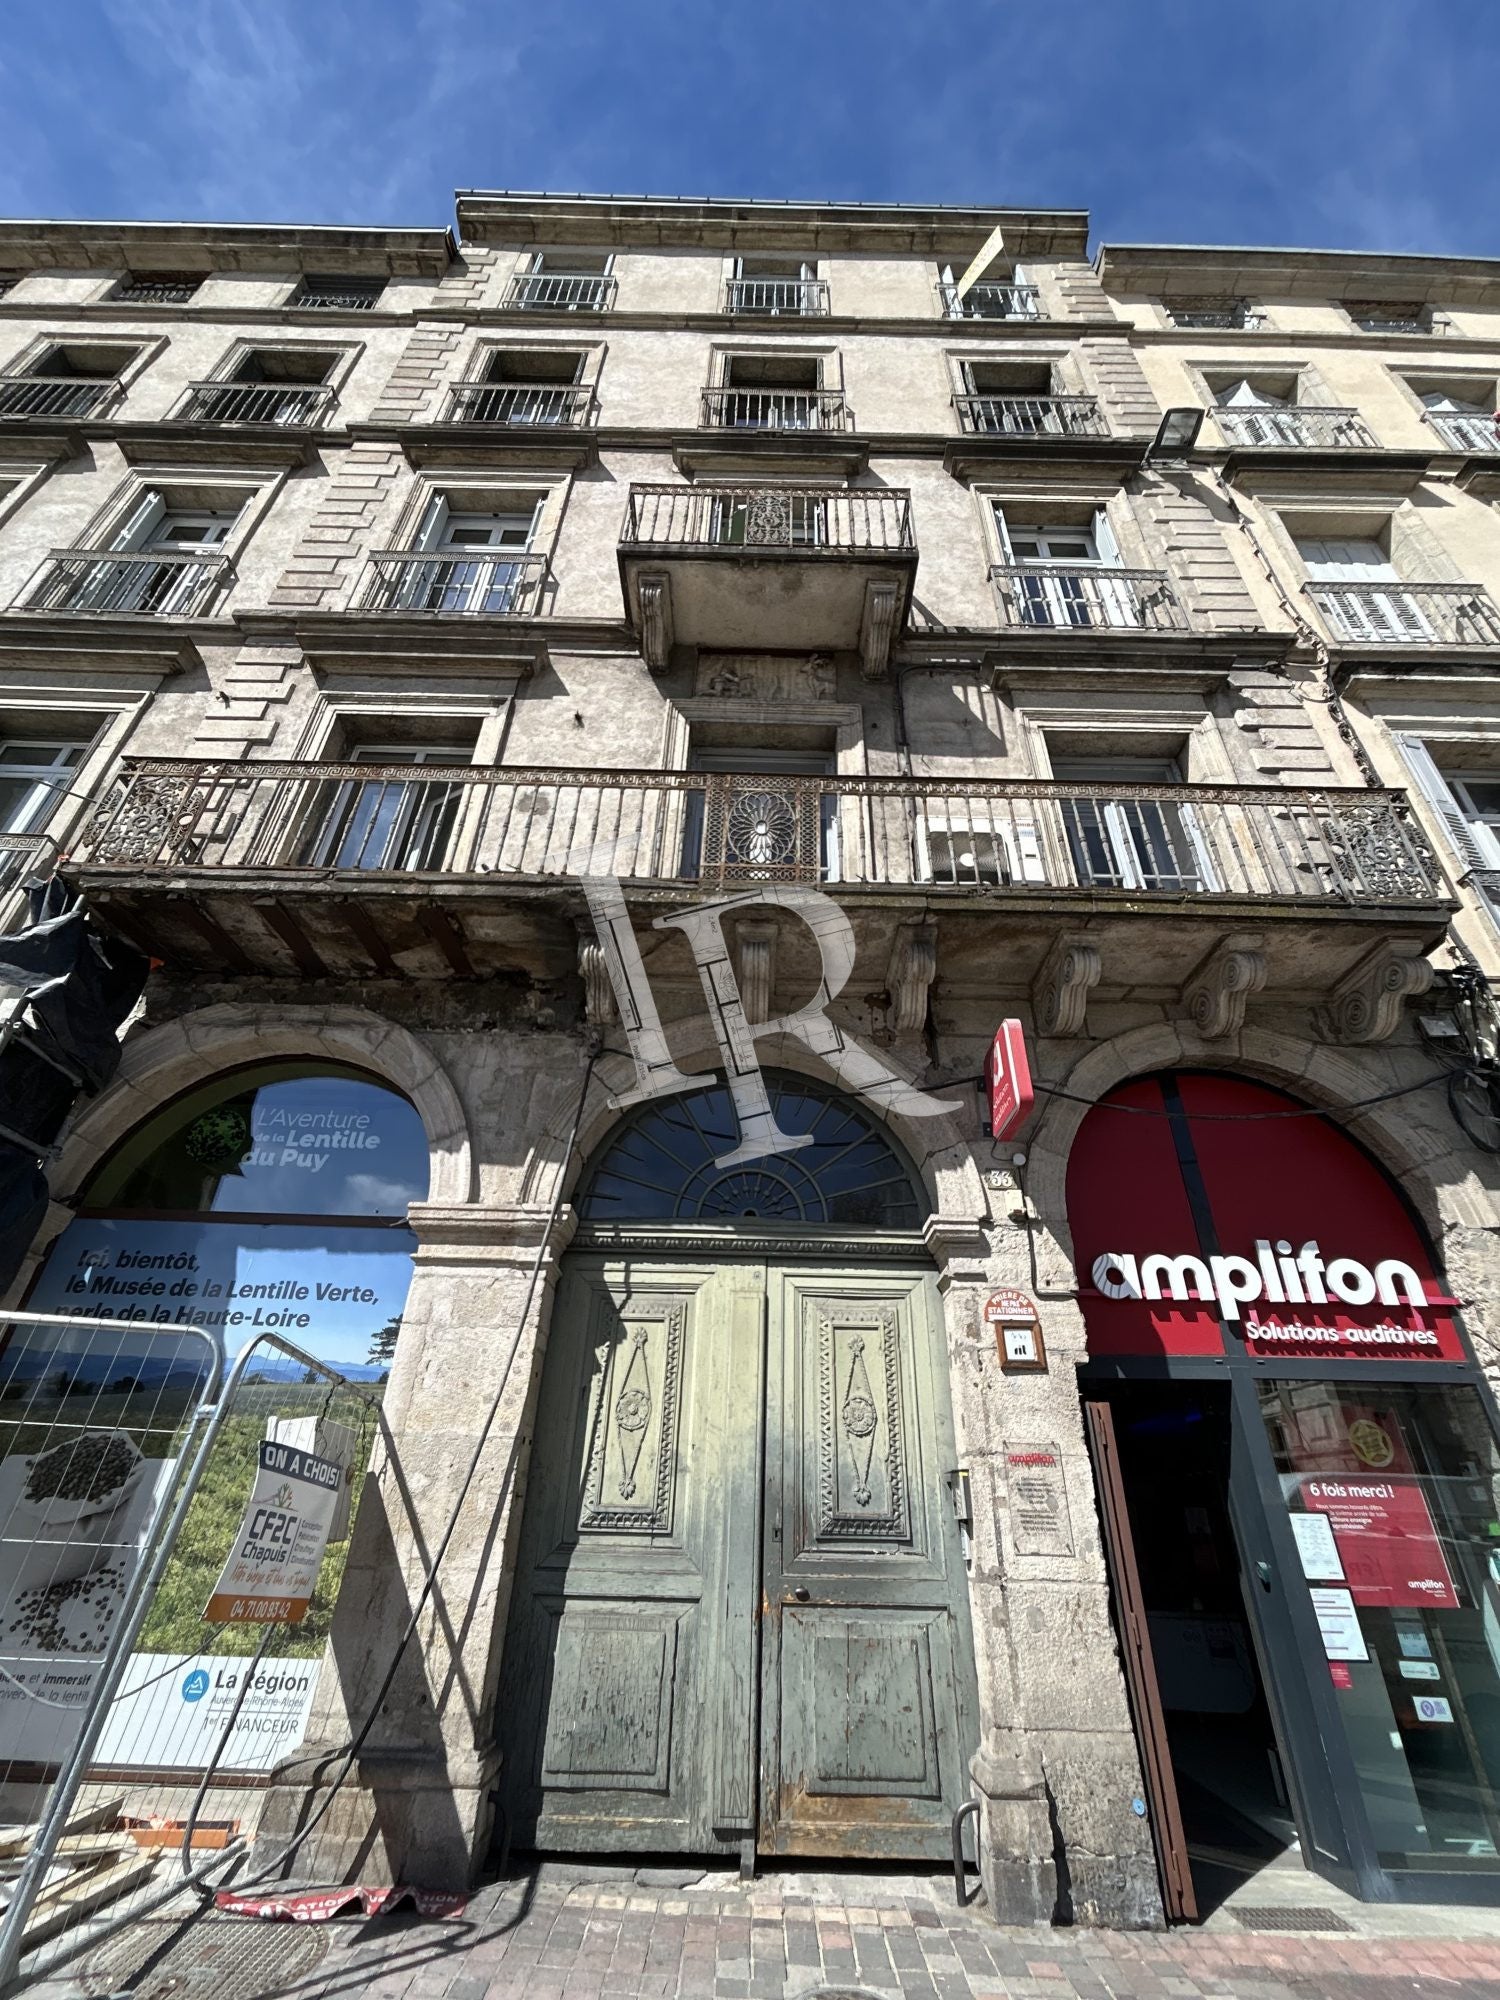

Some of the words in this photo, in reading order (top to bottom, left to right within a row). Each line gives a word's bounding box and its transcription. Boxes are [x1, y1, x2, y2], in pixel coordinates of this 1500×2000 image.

[256, 1104, 371, 1130] L'Aventure
[255, 1132, 271, 1143] de
[272, 1132, 286, 1143] la
[285, 1129, 382, 1150] Lentille
[240, 1147, 276, 1167] du
[278, 1148, 331, 1174] Puy
[990, 1171, 1013, 1188] 33
[77, 1249, 111, 1270] Ici,
[116, 1250, 200, 1273] bientôt,
[65, 1274, 87, 1294] le
[90, 1276, 167, 1297] Musée
[169, 1278, 198, 1298] de
[201, 1278, 222, 1299] la
[225, 1280, 310, 1301] Lentille
[316, 1282, 380, 1306] Verte,
[1091, 1239, 1429, 1321] amplifon
[117, 1303, 148, 1322] de
[150, 1304, 172, 1324] la
[174, 1305, 311, 1329] Haute-Loire
[987, 1306, 1034, 1315] STATIONNER
[1246, 1321, 1340, 1342] Solutions
[1344, 1324, 1439, 1345] auditives
[265, 1446, 288, 1470] ON
[289, 1453, 300, 1475] A
[303, 1458, 341, 1488] CHOISI
[1309, 1483, 1320, 1497] 6
[1321, 1482, 1347, 1498] fois
[1348, 1484, 1388, 1499] merci
[248, 1508, 298, 1545] CF2C
[241, 1541, 287, 1566] Chapuis
[1408, 1579, 1445, 1590] amplifon
[229, 1600, 246, 1618] 04
[43, 1672, 93, 1686] immersif
[214, 1669, 238, 1689] La
[62, 1690, 90, 1702] lentill
[219, 1717, 299, 1734] FNANCEUR
